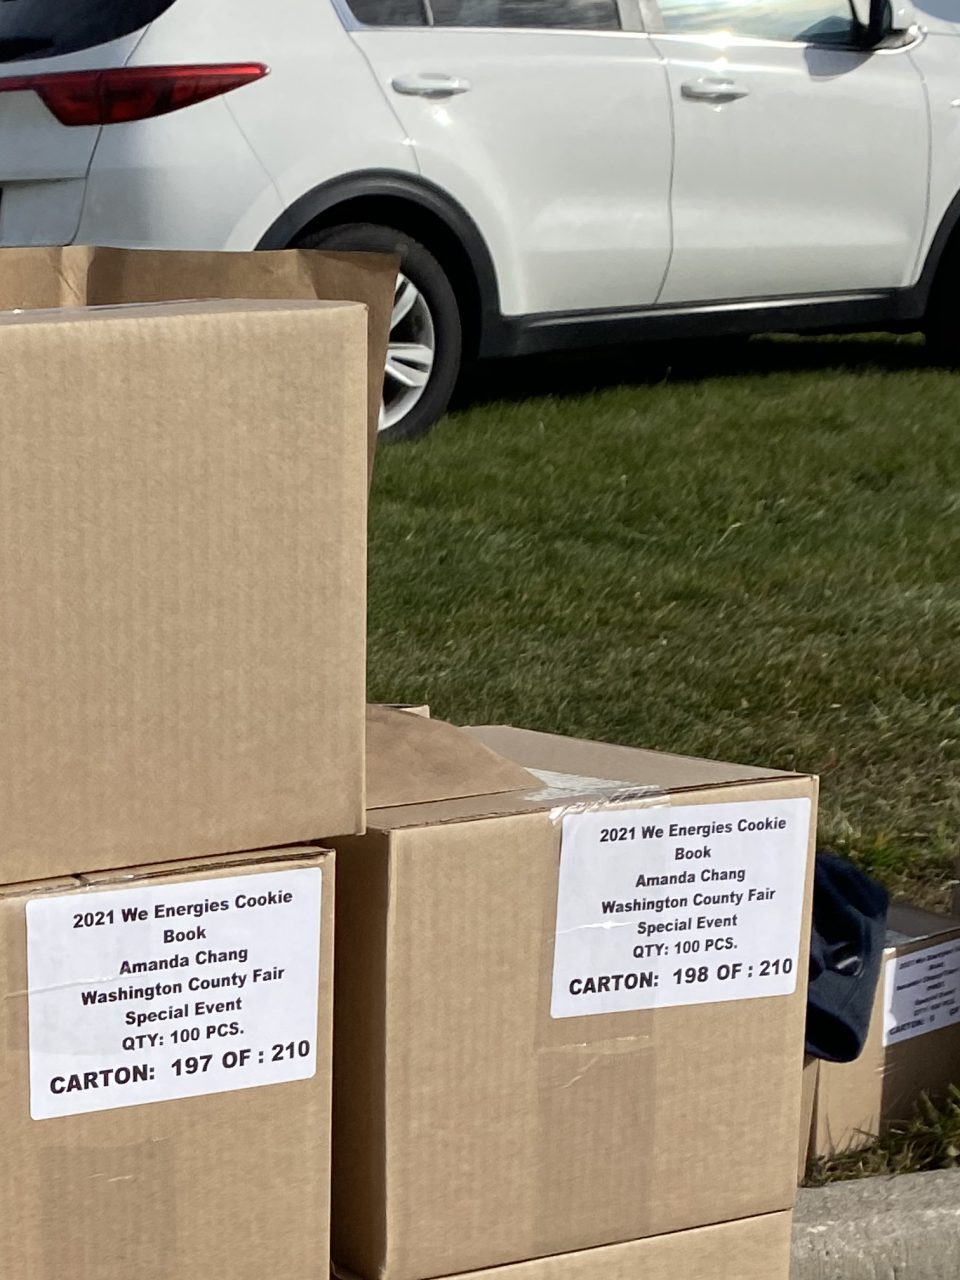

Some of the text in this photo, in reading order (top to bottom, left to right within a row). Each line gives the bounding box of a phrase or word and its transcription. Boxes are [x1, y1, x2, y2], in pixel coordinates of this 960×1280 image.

[599, 816, 787, 843] 2021 We Energies Cookie
[674, 845, 712, 861] Book
[635, 868, 746, 888] Amanda Chang
[72, 889, 293, 929] 2021 We Energies Cookie
[601, 887, 777, 915] Washington County Fair
[163, 925, 207, 944] Book
[636, 914, 738, 937] Special Event
[632, 936, 738, 959] QTY: 100 PCS.
[119, 948, 248, 976] Amanda Chang
[81, 966, 285, 1006] Washington County Fair
[568, 970, 659, 996] CARTON:
[672, 966, 709, 985] 198
[758, 957, 793, 977] 210
[124, 996, 243, 1028] Special Event
[122, 1021, 245, 1051] QTY: 100 PCS.
[49, 1063, 155, 1095] CARTON:
[171, 1054, 213, 1077] 197
[271, 1039, 311, 1063] 210
